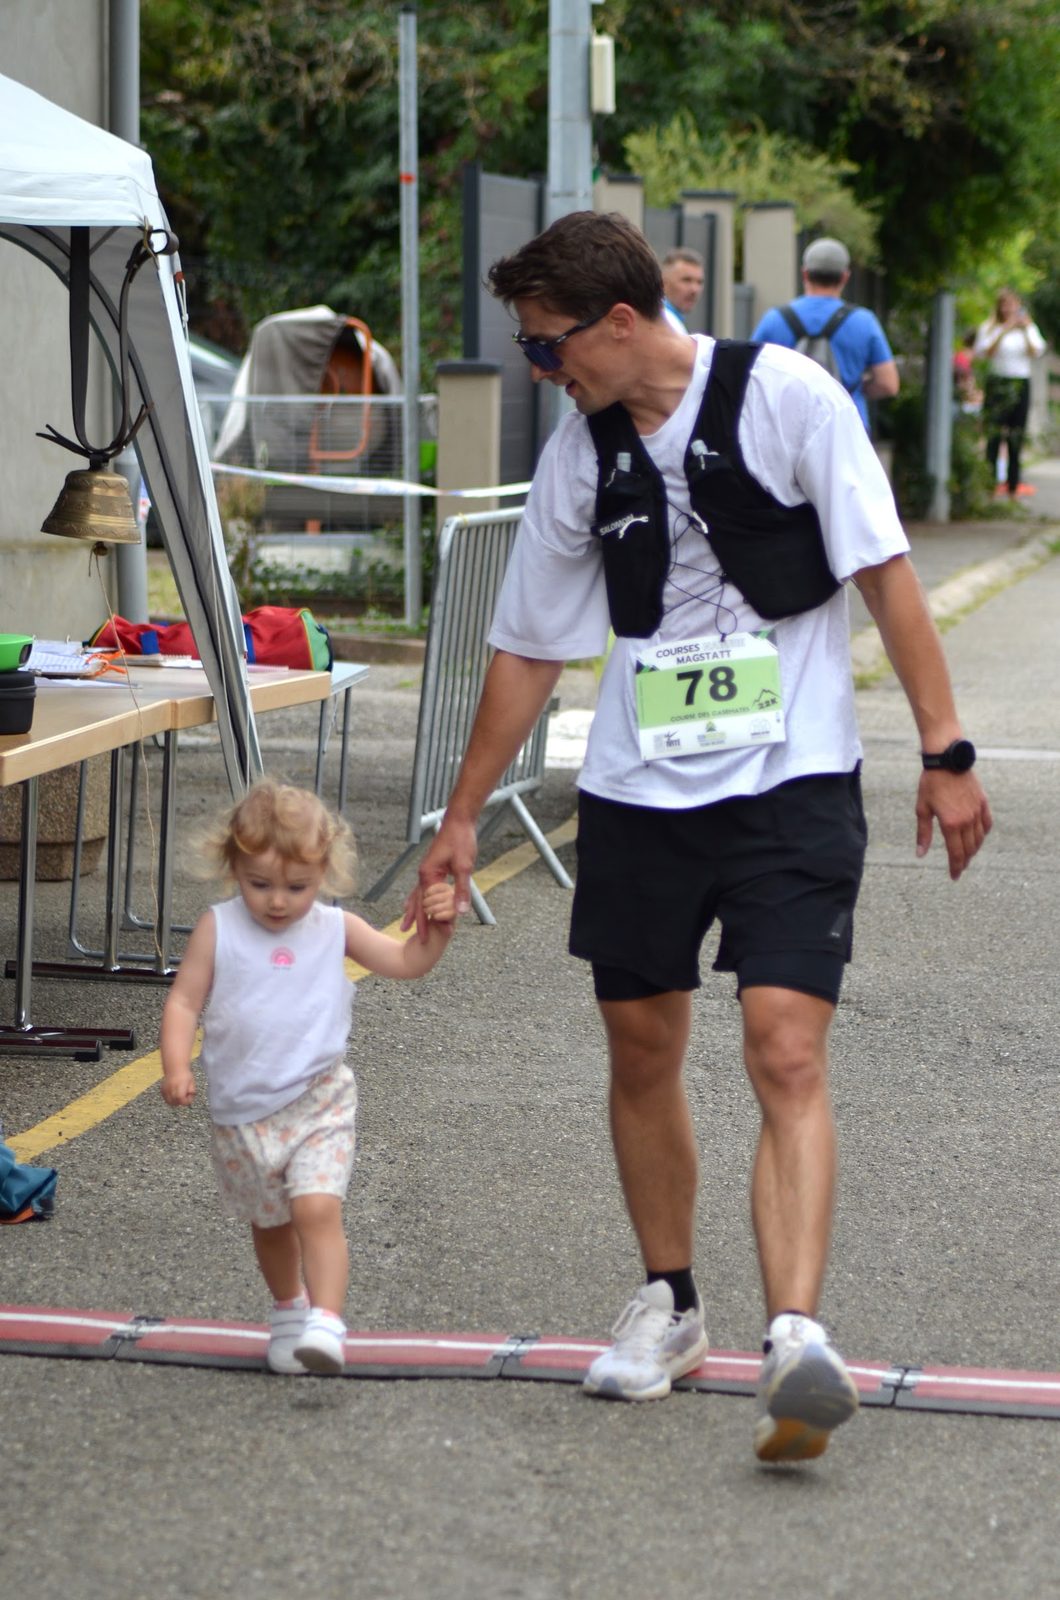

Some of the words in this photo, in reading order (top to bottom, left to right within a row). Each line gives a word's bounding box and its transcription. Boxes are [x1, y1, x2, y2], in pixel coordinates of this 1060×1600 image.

[656, 643, 700, 658] COURSES
[676, 649, 732, 665] MAGSTATT
[676, 666, 738, 706] 78
[670, 713, 695, 722] COURSE
